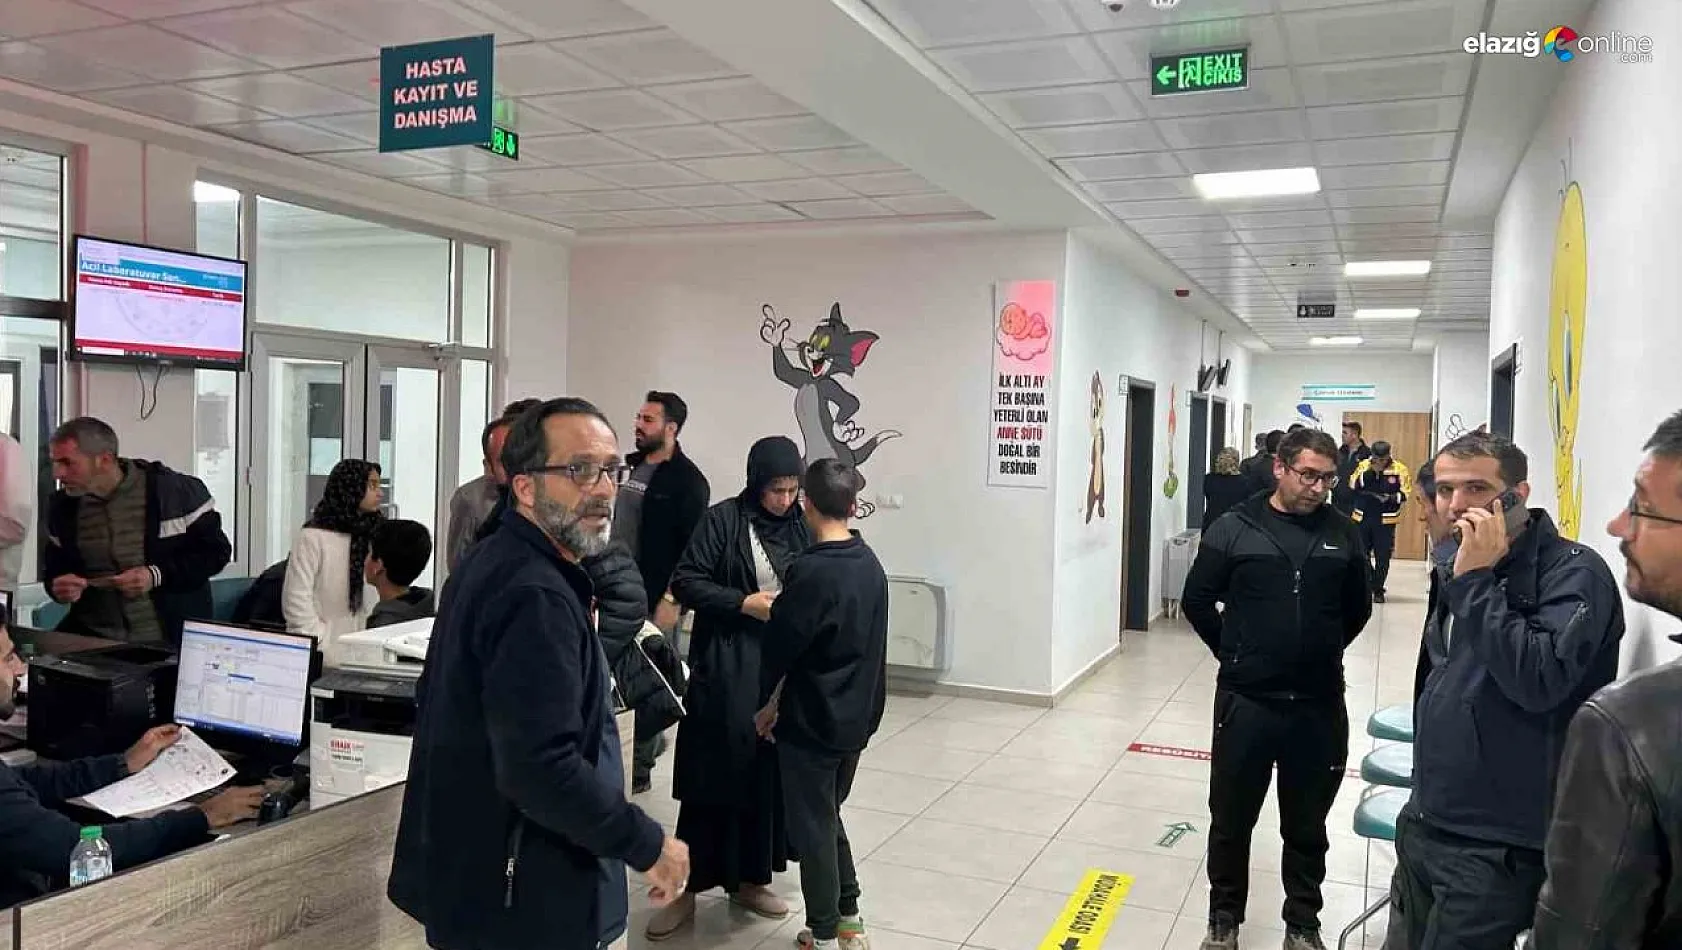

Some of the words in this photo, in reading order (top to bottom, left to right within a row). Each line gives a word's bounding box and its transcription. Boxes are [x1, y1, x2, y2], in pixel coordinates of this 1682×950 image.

[406, 57, 466, 79] HASTA
[1204, 52, 1242, 70] EXIT
[394, 83, 448, 105] KAYIT
[454, 80, 478, 98] VE
[394, 105, 477, 129] DANIŞMA
[999, 372, 1011, 388] İLK
[1013, 375, 1031, 388] ALTI
[1033, 375, 1045, 388] AY
[998, 392, 1012, 405] TEK
[1015, 392, 1045, 408] BAŞINA
[994, 408, 1025, 422] YETERLİ
[1027, 410, 1048, 423] OLAN
[997, 426, 1019, 440] ANNE
[1021, 424, 1042, 440] SÜTÜ
[998, 441, 1024, 457] DOĞAL
[1026, 443, 1041, 458] BİR
[1000, 459, 1037, 475] BESİNDİR
